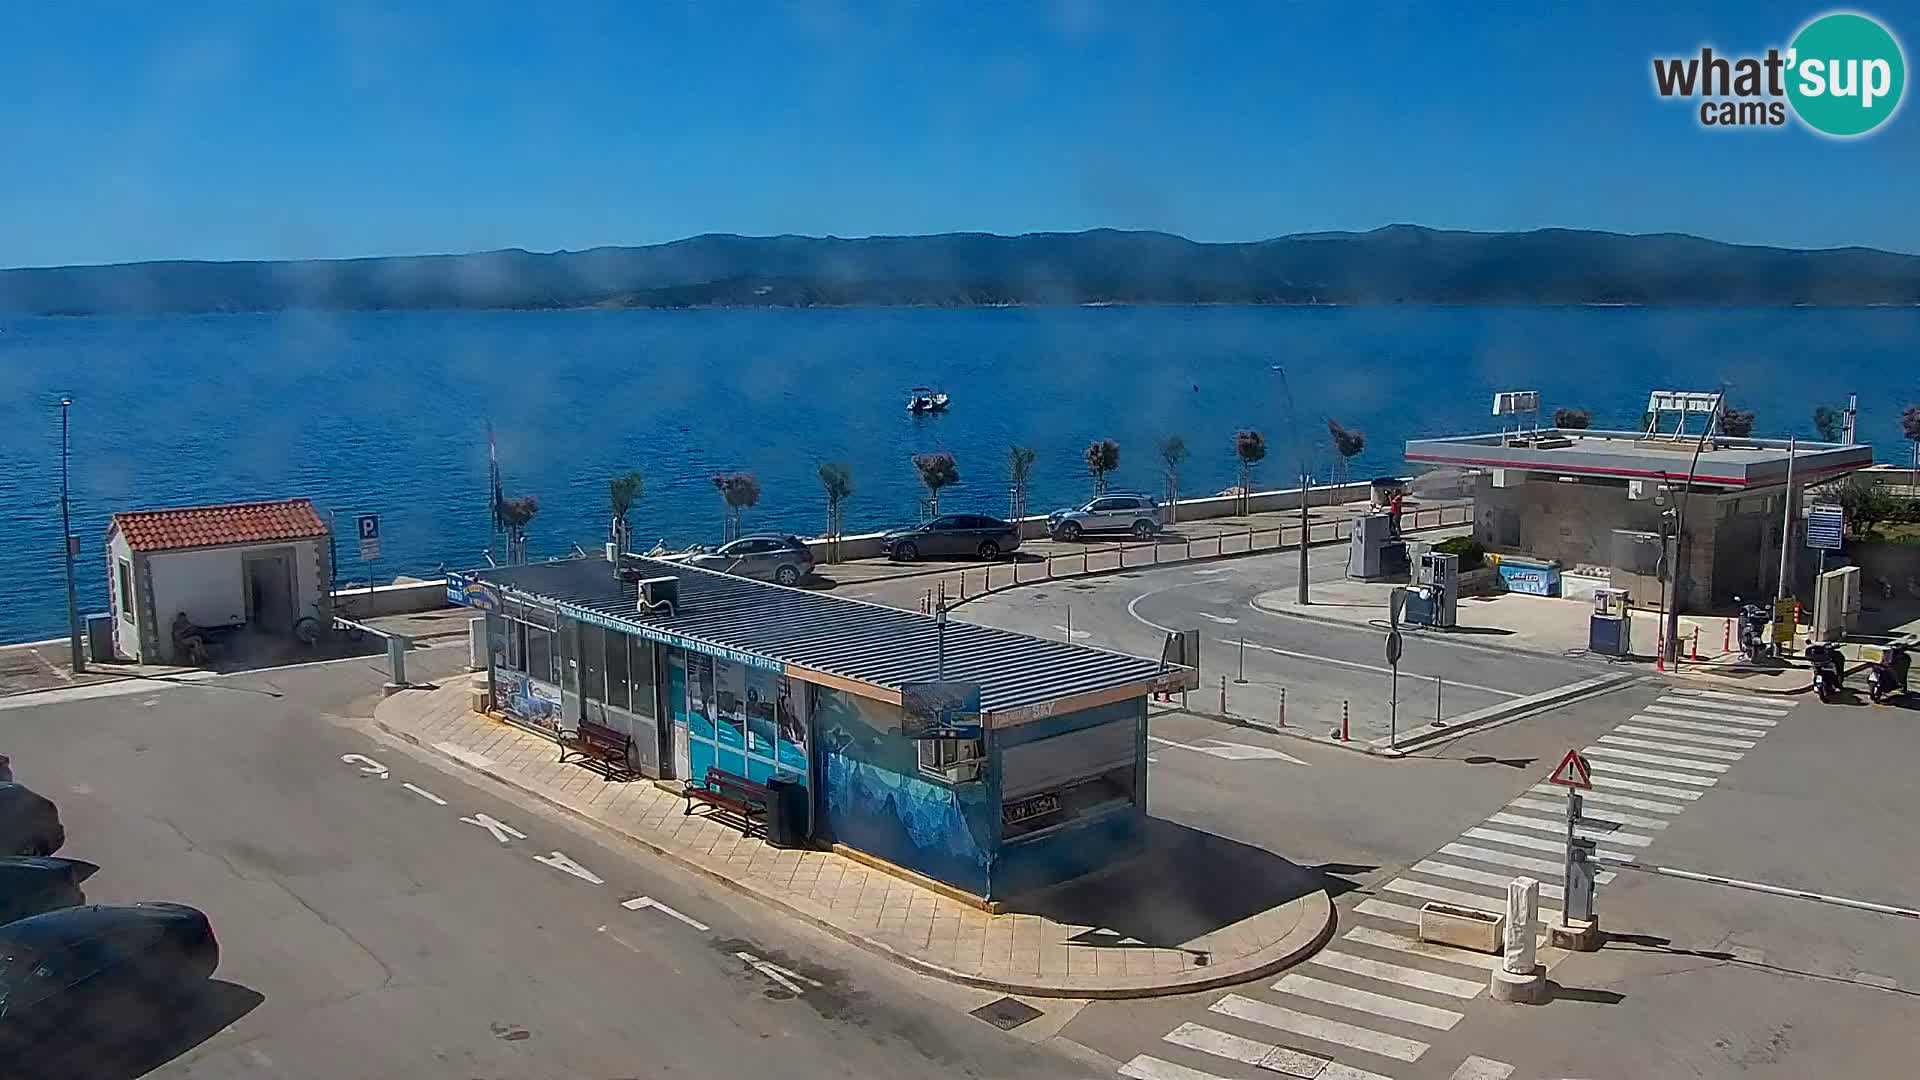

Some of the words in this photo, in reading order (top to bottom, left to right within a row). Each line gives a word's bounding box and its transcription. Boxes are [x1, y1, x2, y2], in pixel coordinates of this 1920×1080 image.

[363, 519, 374, 537] P
[604, 617, 641, 635] AUTOBUSNA
[642, 629, 672, 644] POSTAJA
[682, 639, 696, 651] BUS
[697, 643, 728, 658] STATION
[730, 650, 754, 665] TICKET
[755, 657, 782, 672] OFFICE
